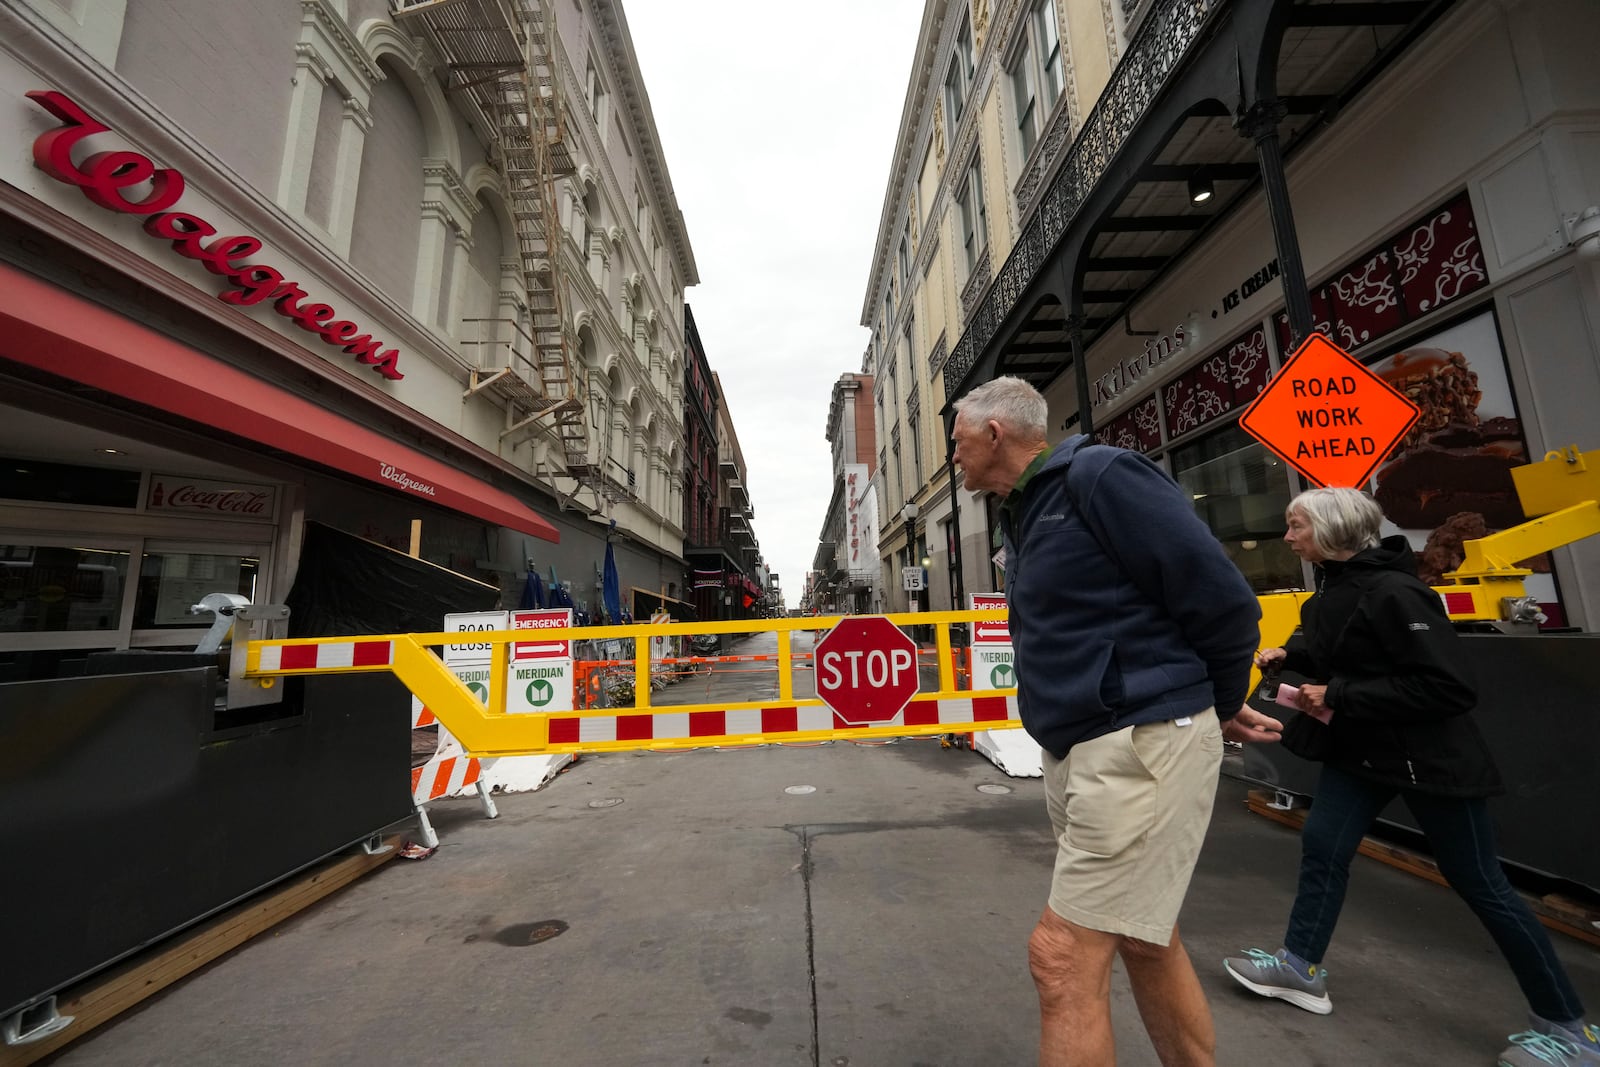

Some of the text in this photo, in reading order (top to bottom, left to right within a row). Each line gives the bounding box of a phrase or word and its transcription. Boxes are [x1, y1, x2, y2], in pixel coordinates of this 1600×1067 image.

[25, 90, 405, 381] Walgreens
[1222, 258, 1280, 315] ICE CREAM
[1093, 323, 1187, 407] Kilwins
[1292, 376, 1356, 398] ROAD
[1296, 407, 1363, 428] WORK
[1296, 437, 1375, 459] AHEAD
[379, 462, 436, 497] Walgreens
[167, 484, 268, 514] Coca-Cola
[907, 579, 920, 588] 15
[515, 618, 568, 629] EMERGENCY
[450, 642, 492, 651] CLOSE
[980, 652, 1013, 663] MERIDI
[516, 667, 564, 680] MERIDIAN
[821, 649, 912, 690] STOP
